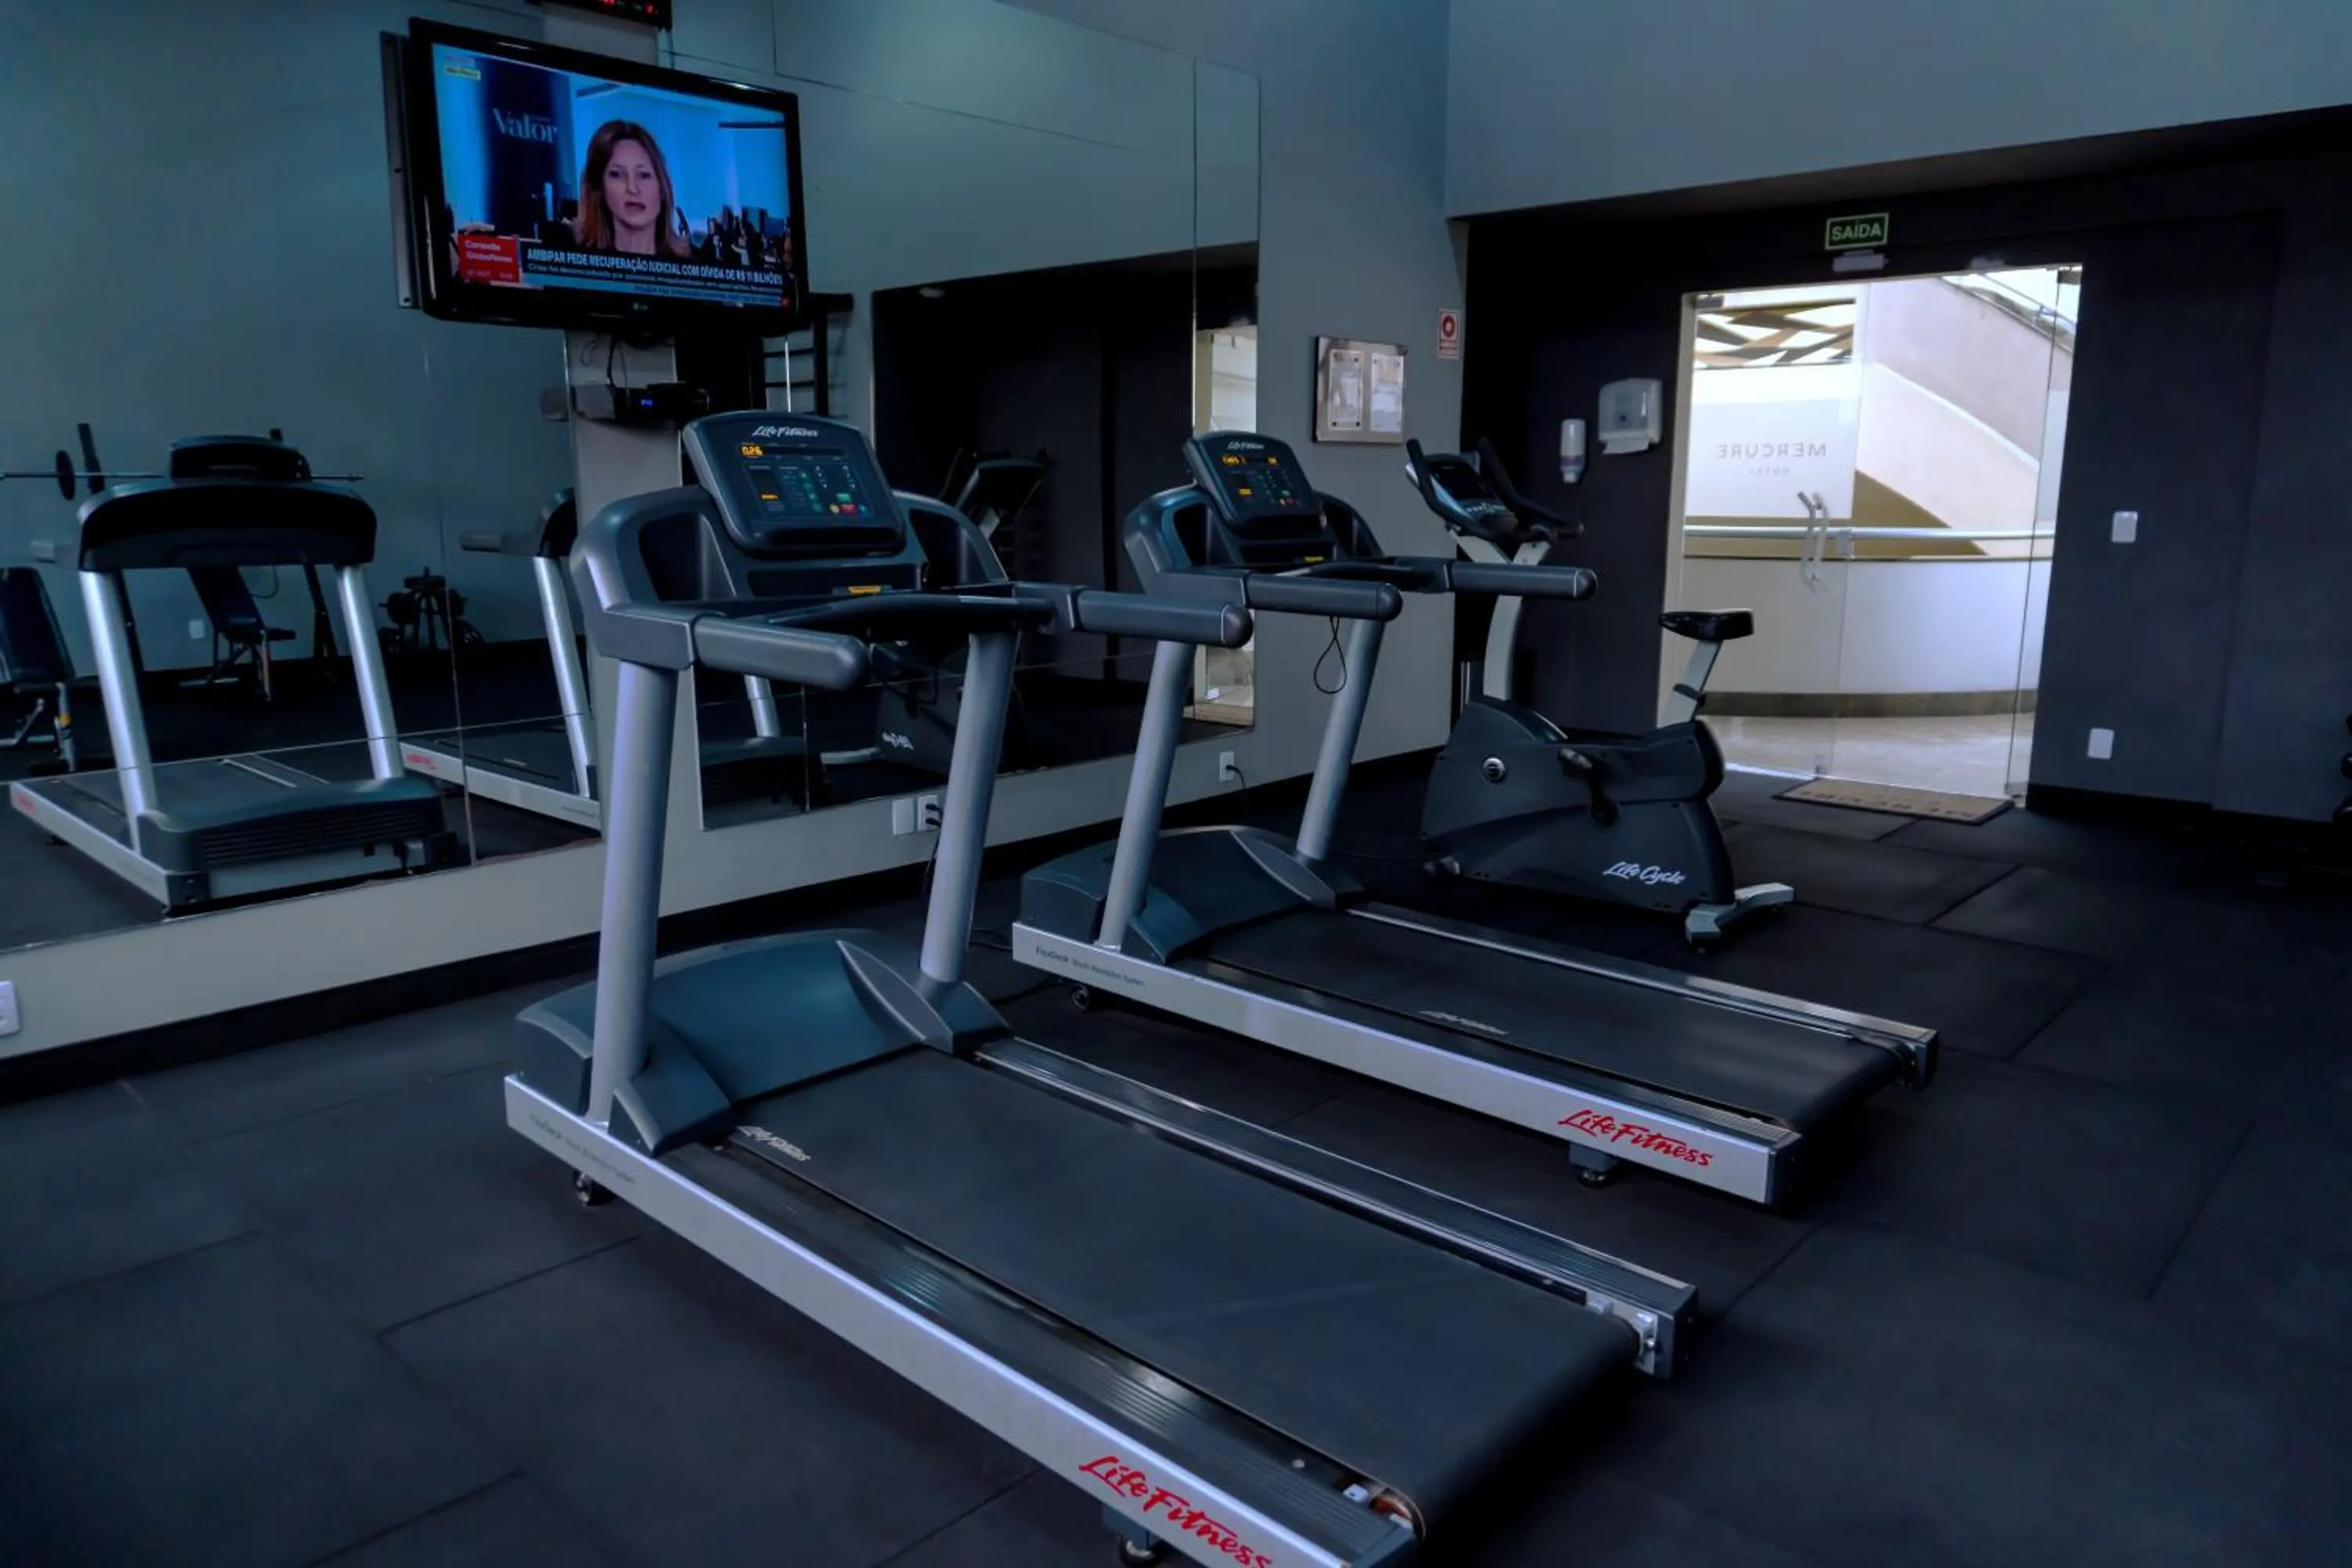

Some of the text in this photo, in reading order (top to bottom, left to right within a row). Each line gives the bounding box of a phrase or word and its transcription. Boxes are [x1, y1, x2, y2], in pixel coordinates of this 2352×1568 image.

[492, 107, 558, 143] Valor
[1831, 220, 1882, 241] SAÍDA
[566, 251, 589, 266] PEDE
[648, 261, 683, 275] JUDICIAL
[683, 263, 700, 277] COM
[725, 268, 736, 281] DE
